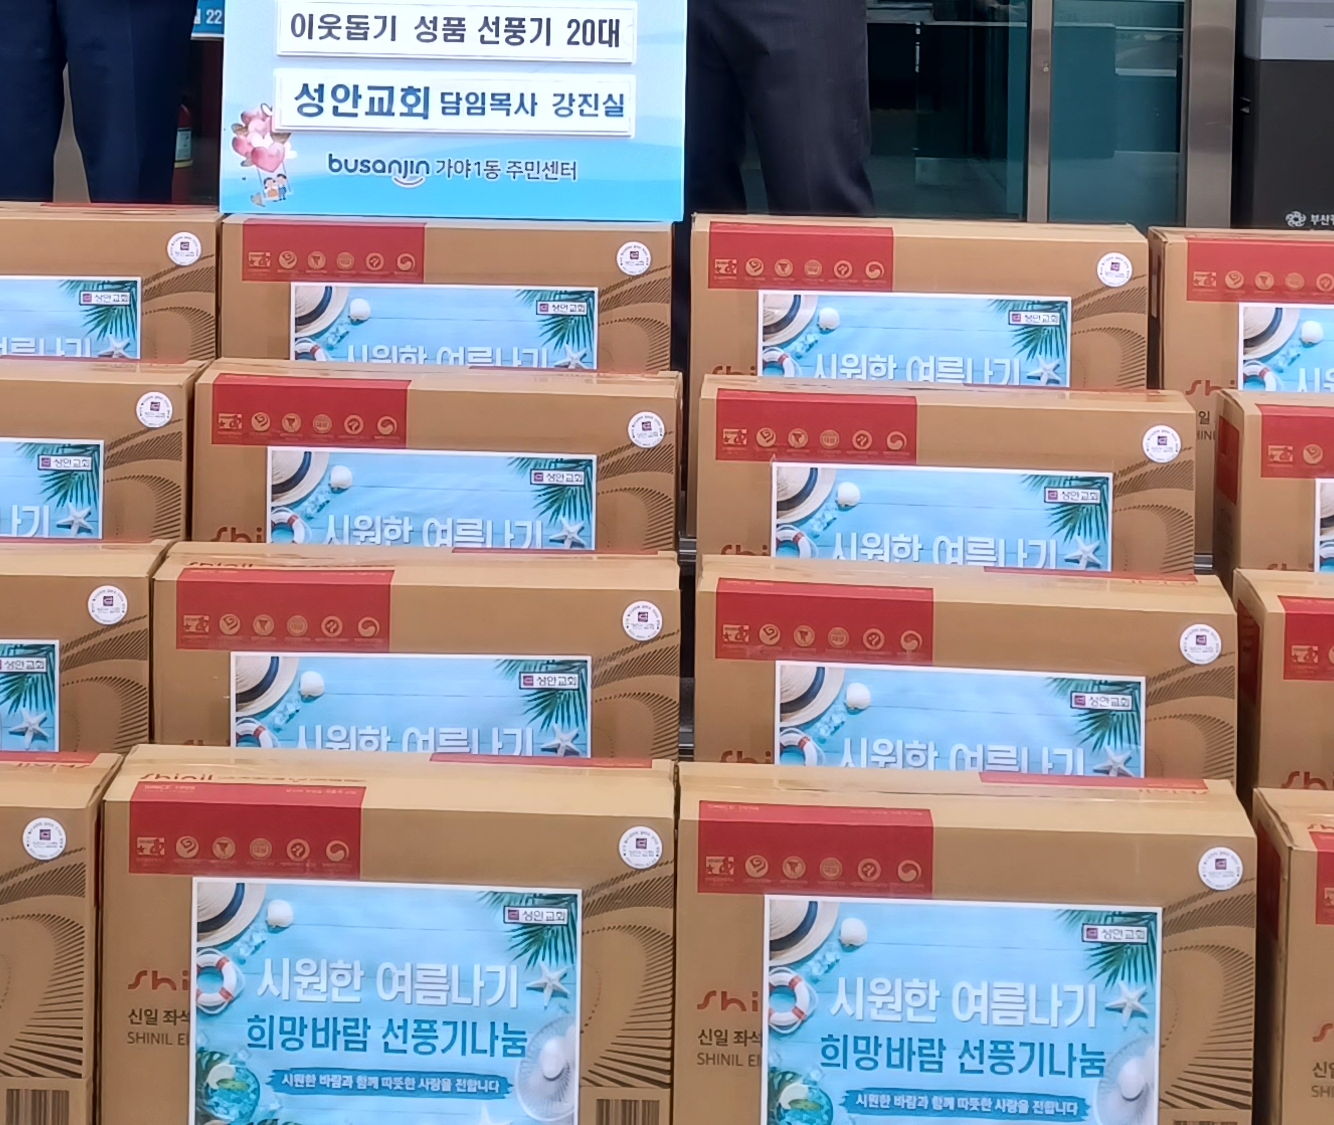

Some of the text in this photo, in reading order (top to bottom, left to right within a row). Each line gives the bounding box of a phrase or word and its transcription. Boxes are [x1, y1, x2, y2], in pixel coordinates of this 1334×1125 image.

[290, 12, 622, 48] 이웃돕기 성품 선풍기 20대
[294, 83, 625, 120] 성안교회 담임목사 강진실
[328, 153, 578, 181] busanjin 가야1동 주민센터
[522, 908, 566, 922] 성안교회
[1101, 927, 1146, 941] 성안교회
[257, 957, 518, 1008] 시원한 여름나기
[829, 976, 1097, 1028] 시원한 여름나기
[128, 1008, 158, 1026] 신일
[127, 1031, 173, 1045] SHINIL
[247, 1014, 527, 1058] 희망바람 선풍기나눔
[698, 1028, 728, 1046] 신일
[697, 1052, 744, 1066] SHINIL
[820, 1034, 1107, 1079] 희망바람 선풍기나눔
[282, 1073, 316, 1088] 시원한
[856, 1093, 891, 1108] 시원한
